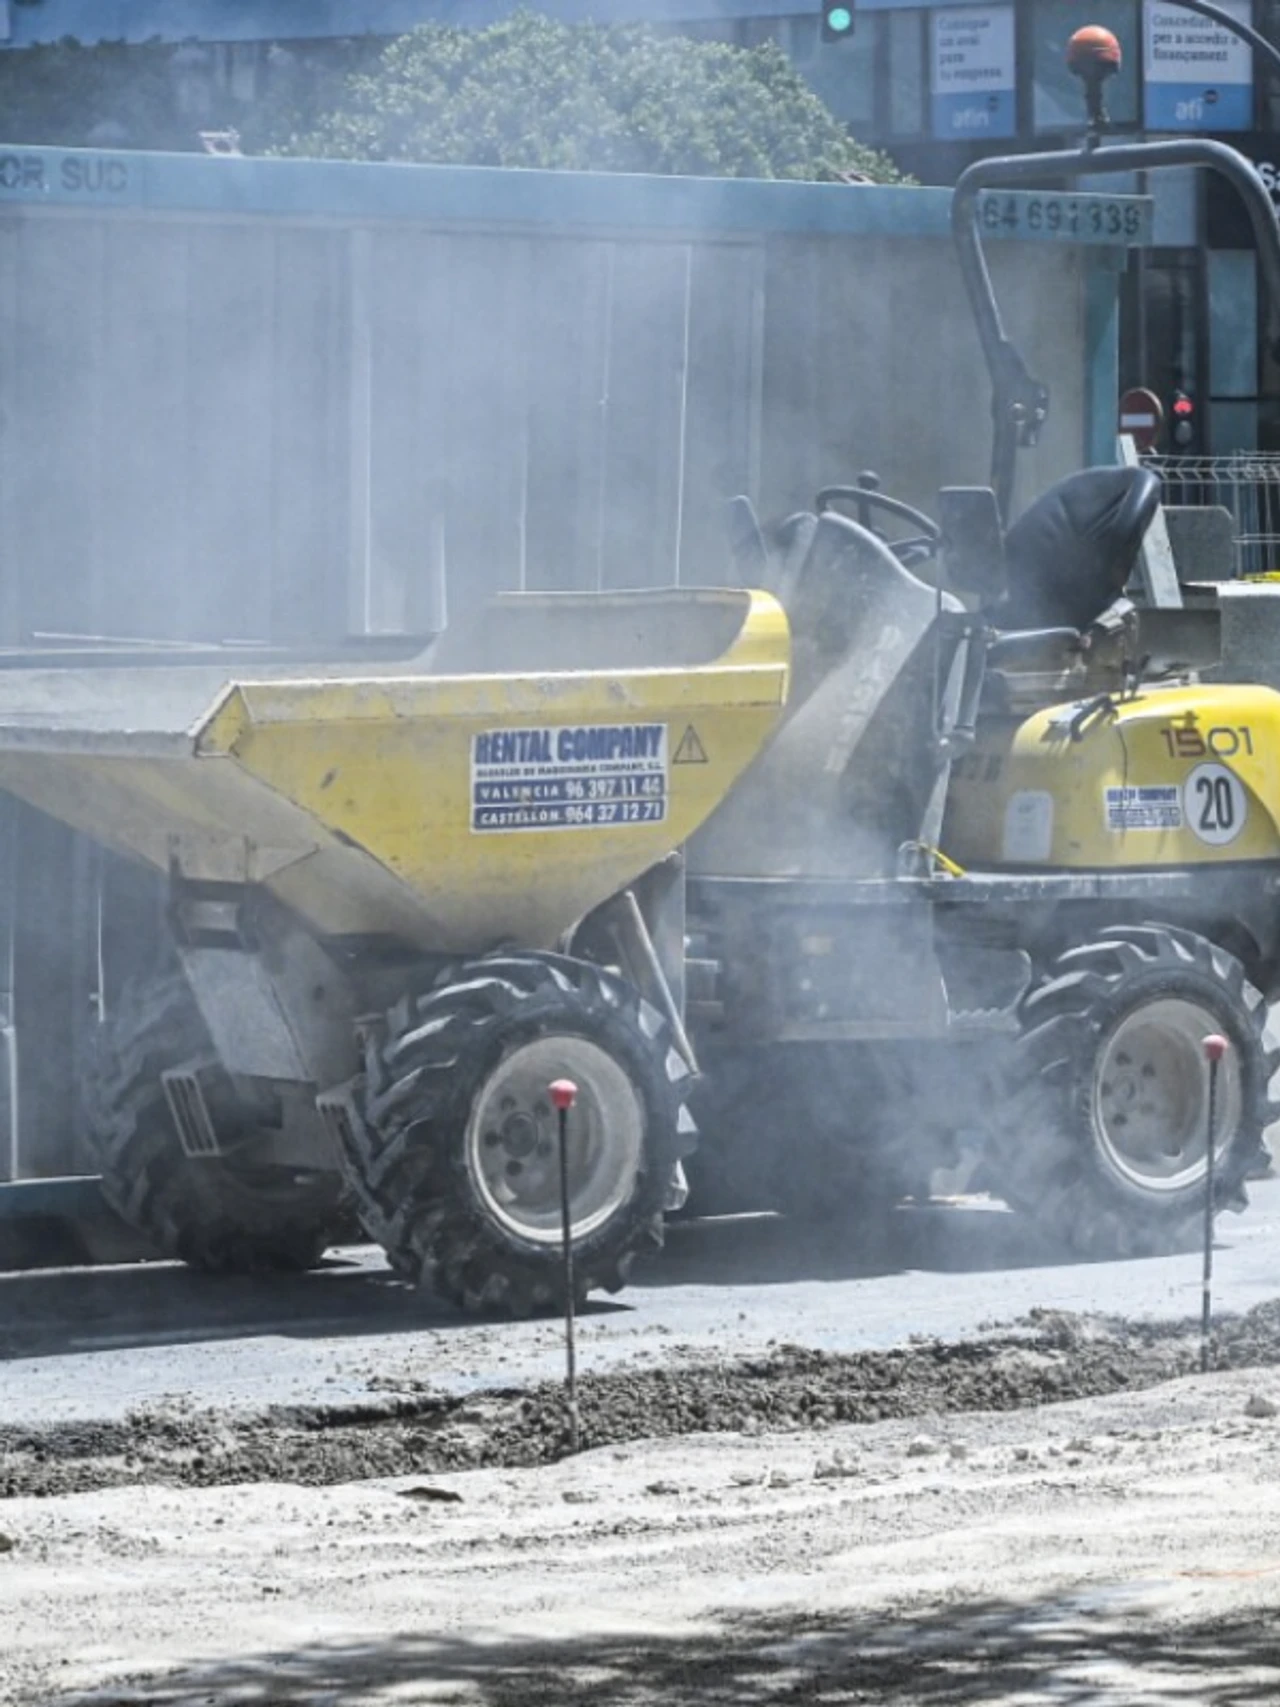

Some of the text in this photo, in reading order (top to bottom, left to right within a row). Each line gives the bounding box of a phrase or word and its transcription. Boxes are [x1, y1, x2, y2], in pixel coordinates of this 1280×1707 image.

[475, 725, 663, 765] RENTAL COMPANY
[1160, 726, 1254, 758] 1501
[480, 784, 560, 801] VALENCIA
[564, 780, 584, 799] 96
[588, 779, 616, 798] 397
[621, 777, 637, 796] 11
[1196, 776, 1235, 831] 20
[622, 802, 640, 820] 12
[643, 801, 661, 819] 71
